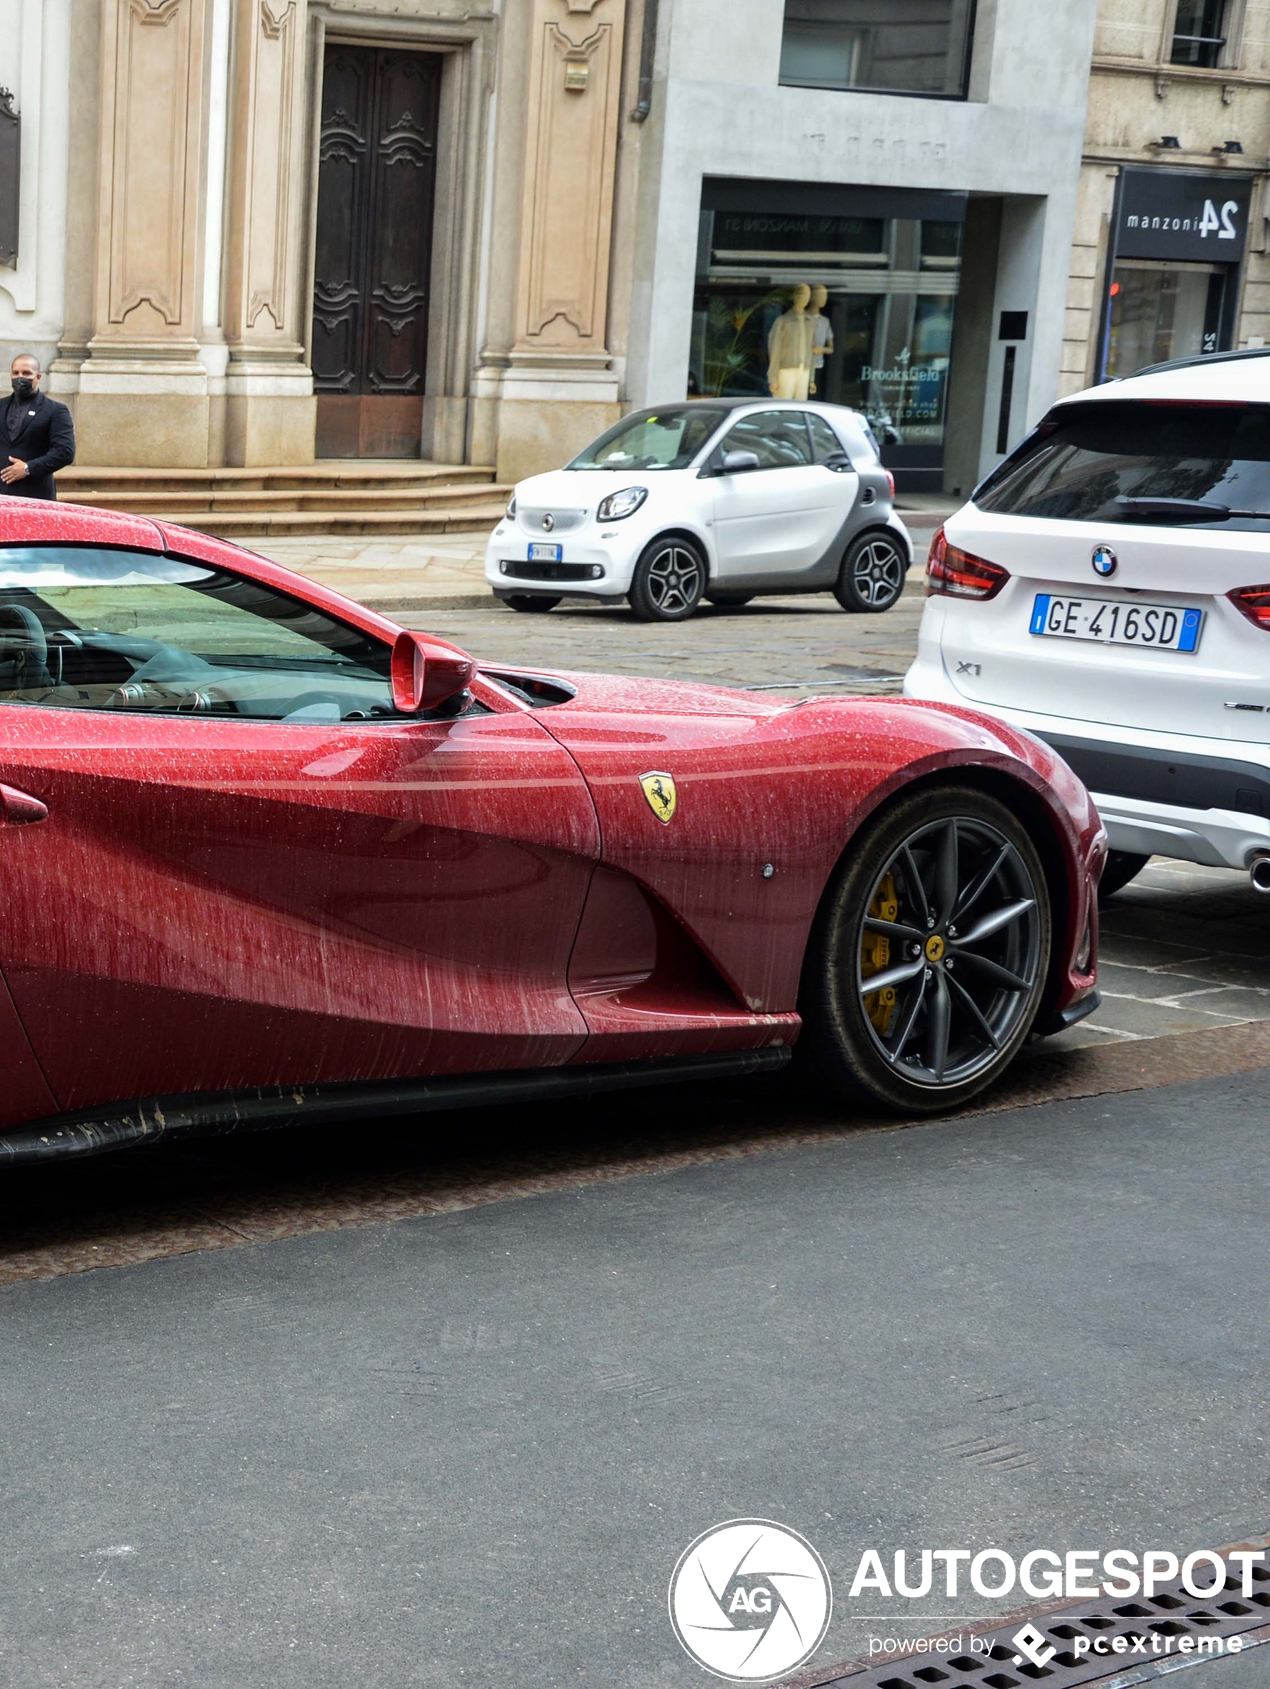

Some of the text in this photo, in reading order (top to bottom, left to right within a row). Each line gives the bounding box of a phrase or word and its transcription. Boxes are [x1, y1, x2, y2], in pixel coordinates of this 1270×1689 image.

[1127, 214, 1198, 231] manzoni
[861, 366, 939, 381] Brooksfield
[956, 660, 981, 677] X1
